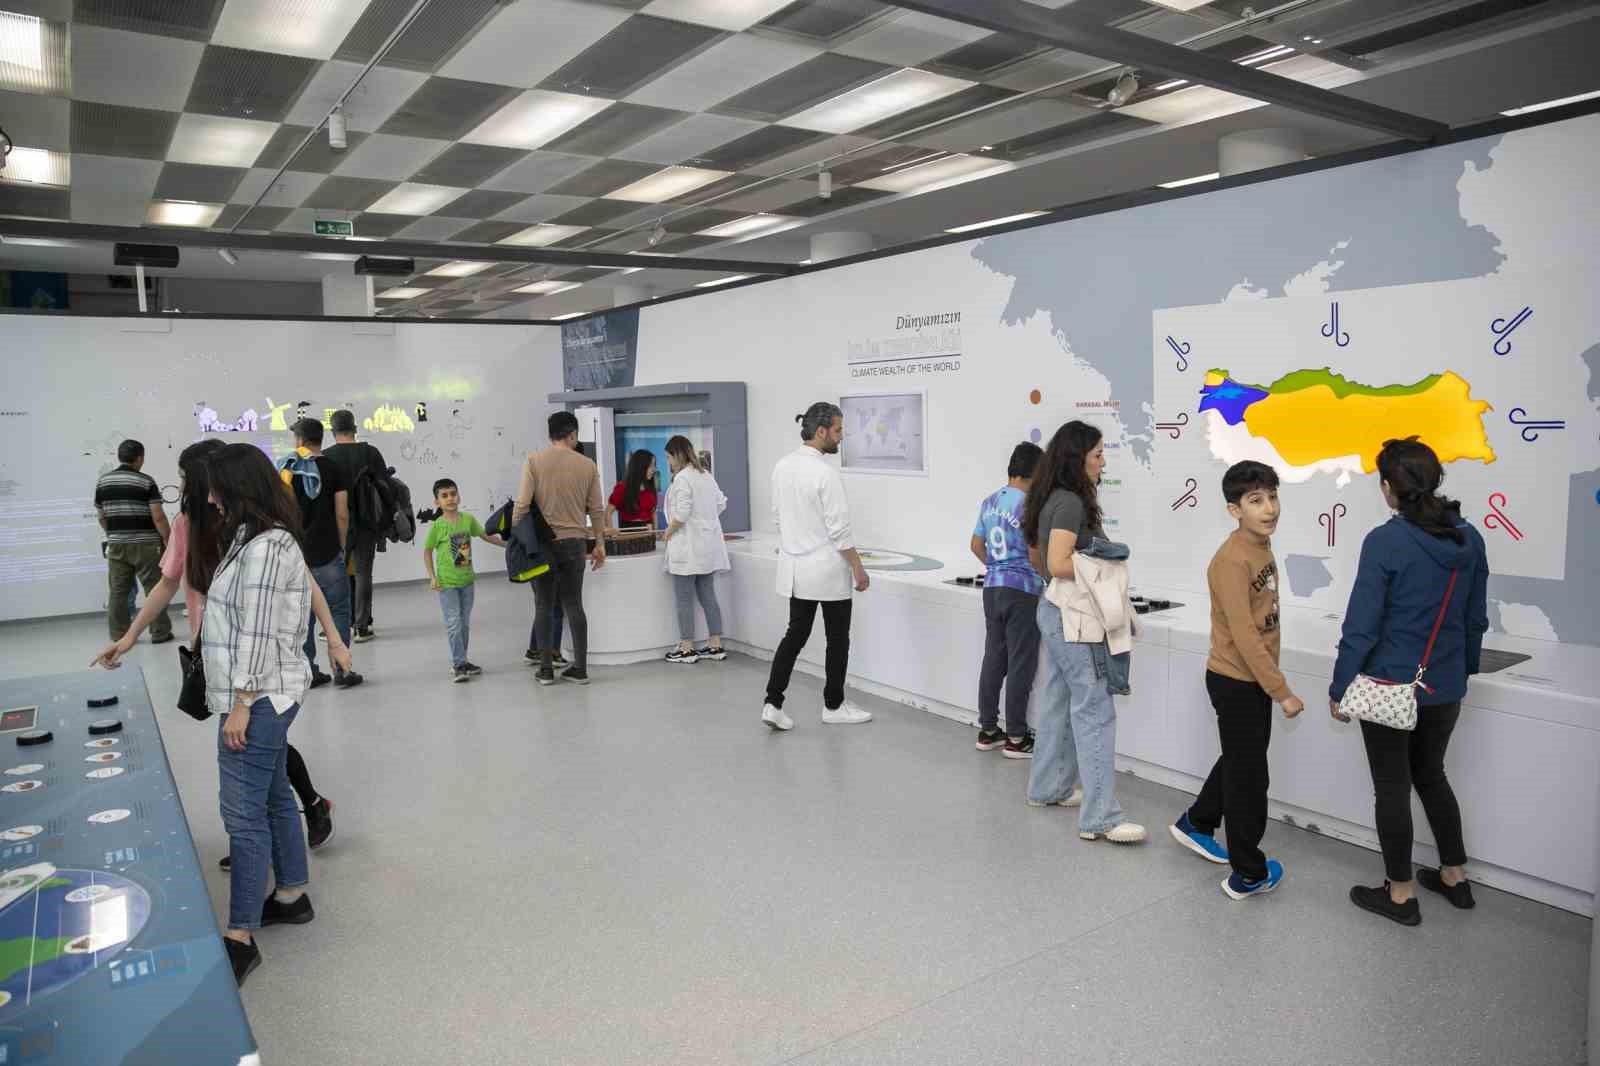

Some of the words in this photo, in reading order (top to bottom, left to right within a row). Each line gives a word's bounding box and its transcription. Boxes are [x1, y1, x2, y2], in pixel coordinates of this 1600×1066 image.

[896, 311, 961, 332] Dünyamızın
[851, 367, 878, 377] CLIMATE
[879, 366, 905, 376] WEALTH
[906, 364, 917, 374] OF
[918, 363, 932, 373] THE
[933, 361, 960, 372] WORLD
[990, 525, 1008, 561] 9
